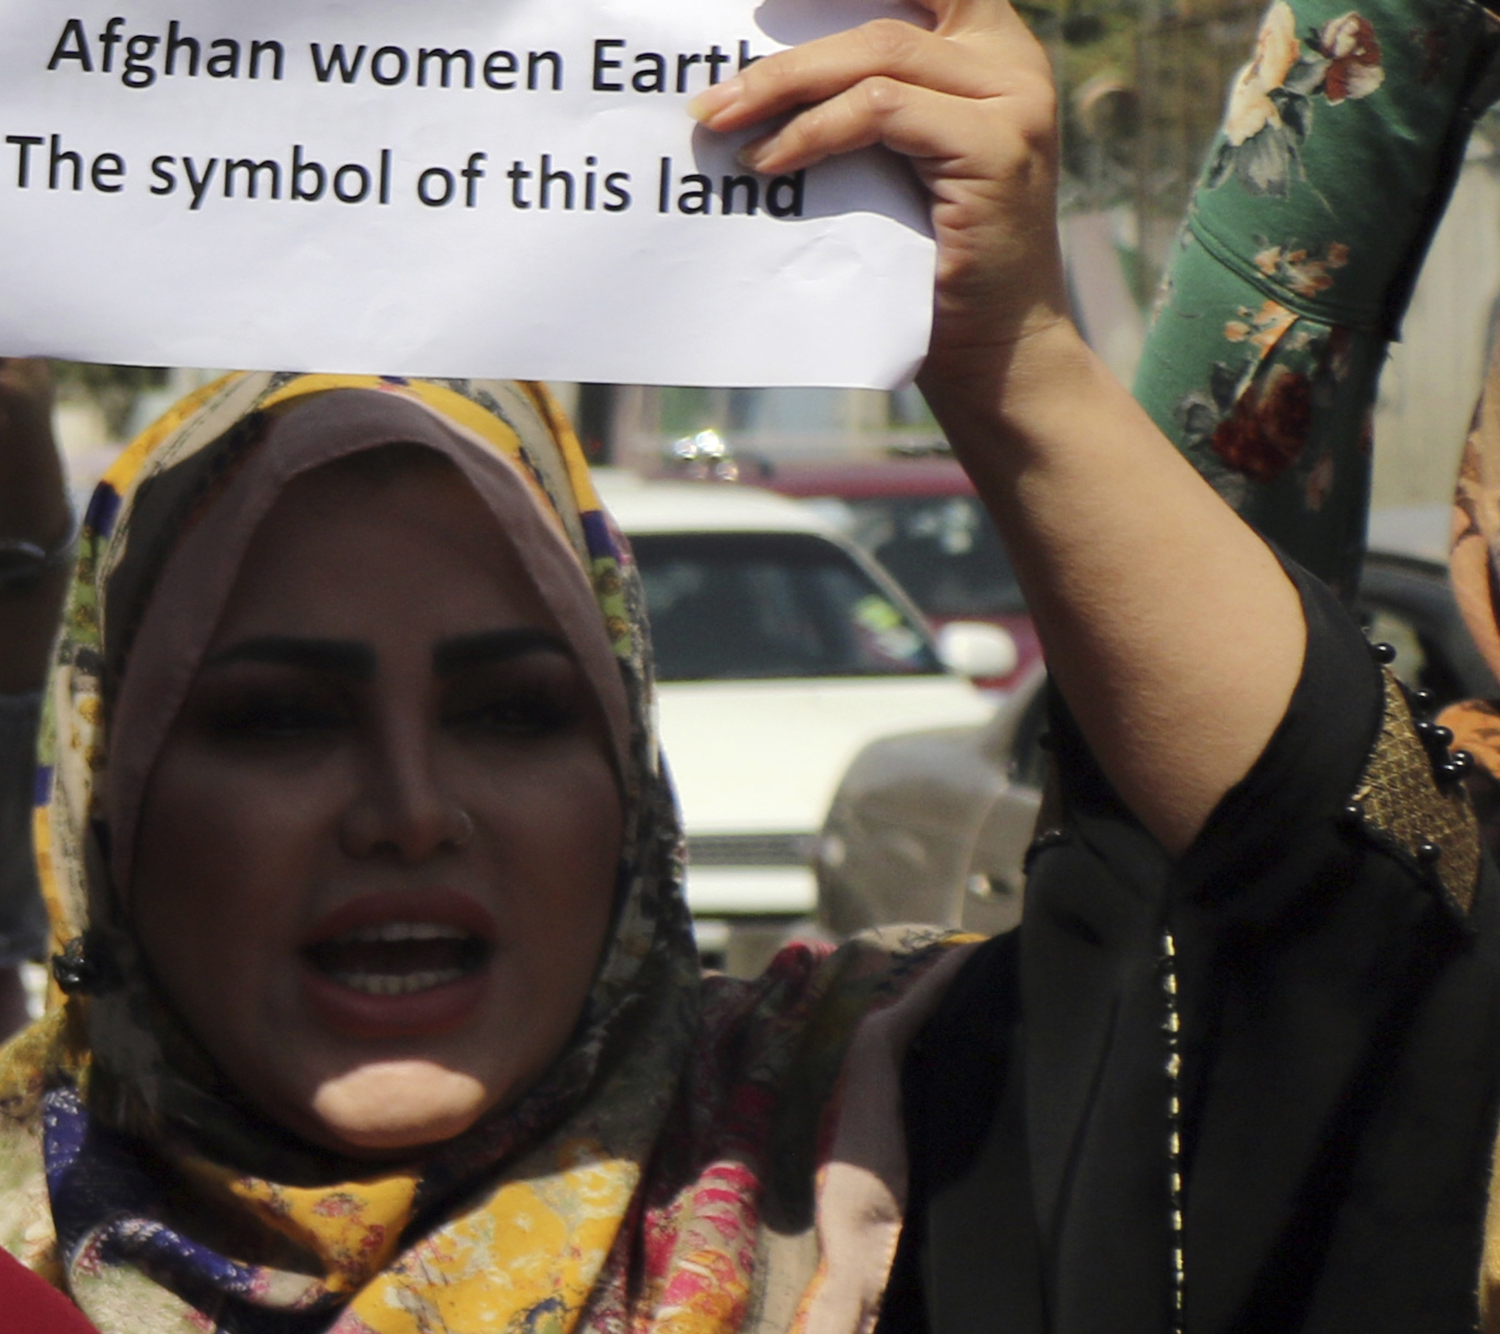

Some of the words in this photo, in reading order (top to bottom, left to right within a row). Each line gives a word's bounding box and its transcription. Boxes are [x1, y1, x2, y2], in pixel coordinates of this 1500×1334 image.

[47, 17, 283, 88] Afghan
[310, 43, 562, 90] women
[6, 134, 125, 193] The
[150, 145, 390, 210] symbol
[417, 152, 486, 207] of
[507, 154, 631, 212] this
[657, 156, 808, 218] land
